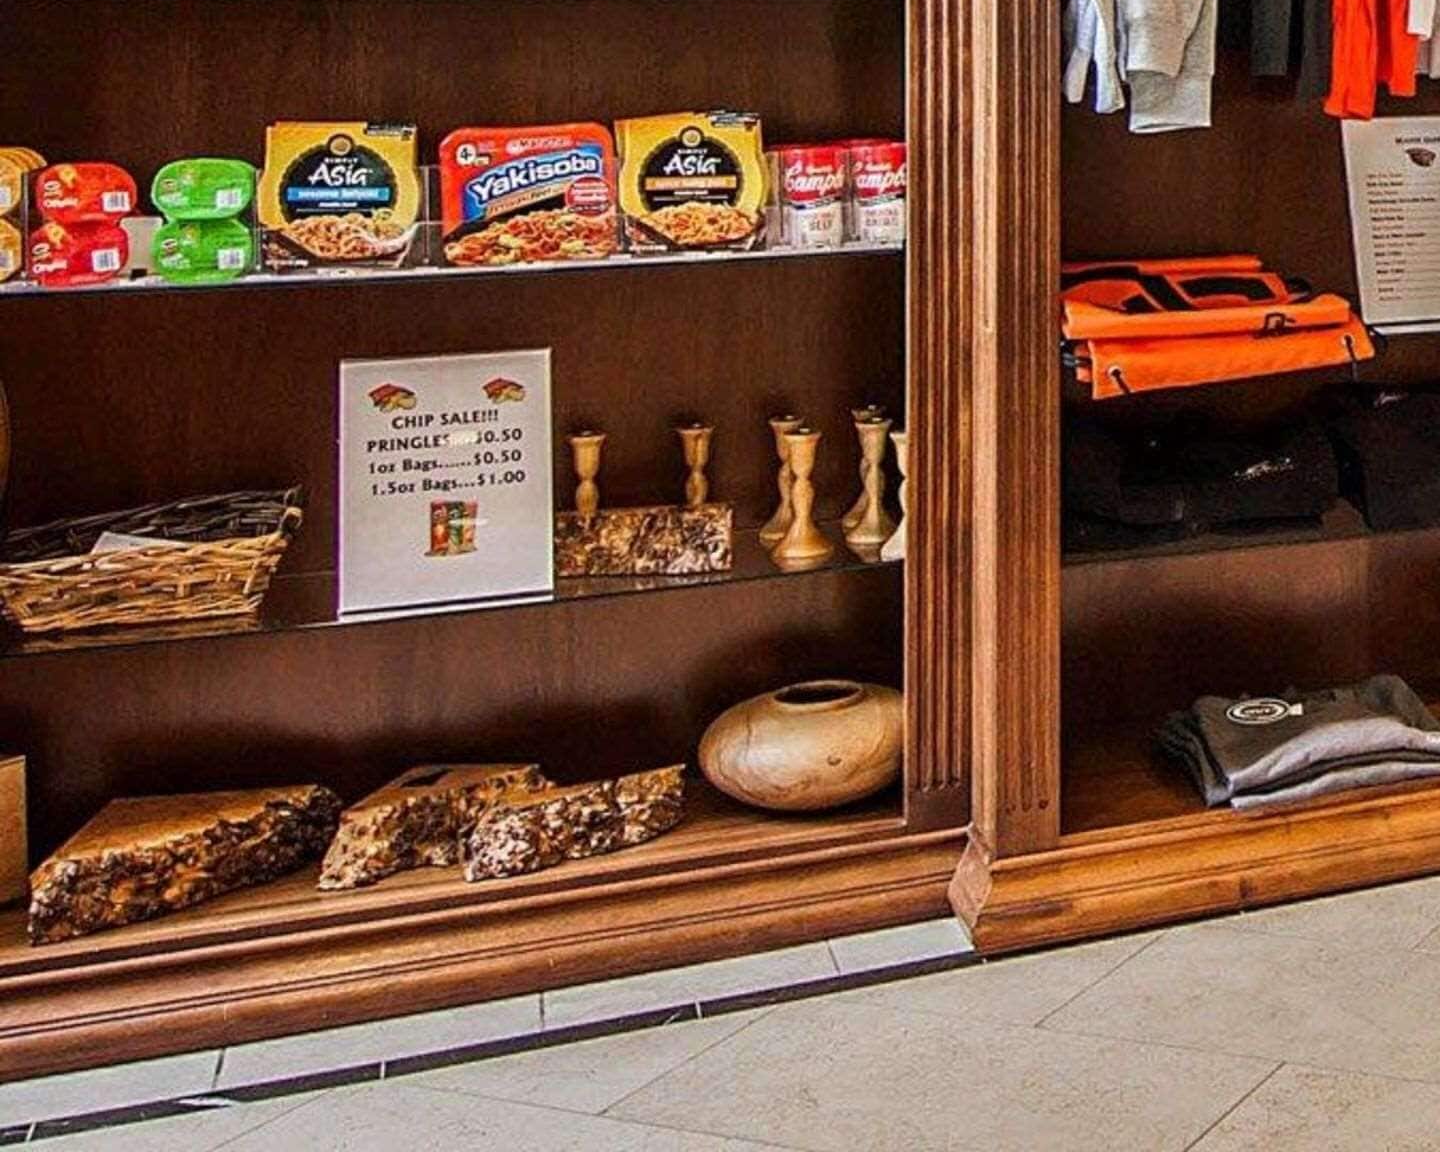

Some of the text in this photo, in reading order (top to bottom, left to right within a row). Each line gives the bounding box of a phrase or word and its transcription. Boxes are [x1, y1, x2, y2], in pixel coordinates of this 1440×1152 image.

[308, 163, 367, 186] Asia
[663, 153, 721, 176] Asia
[472, 153, 597, 202] Yakisoba
[391, 409, 499, 430] CHIP SALE!!!
